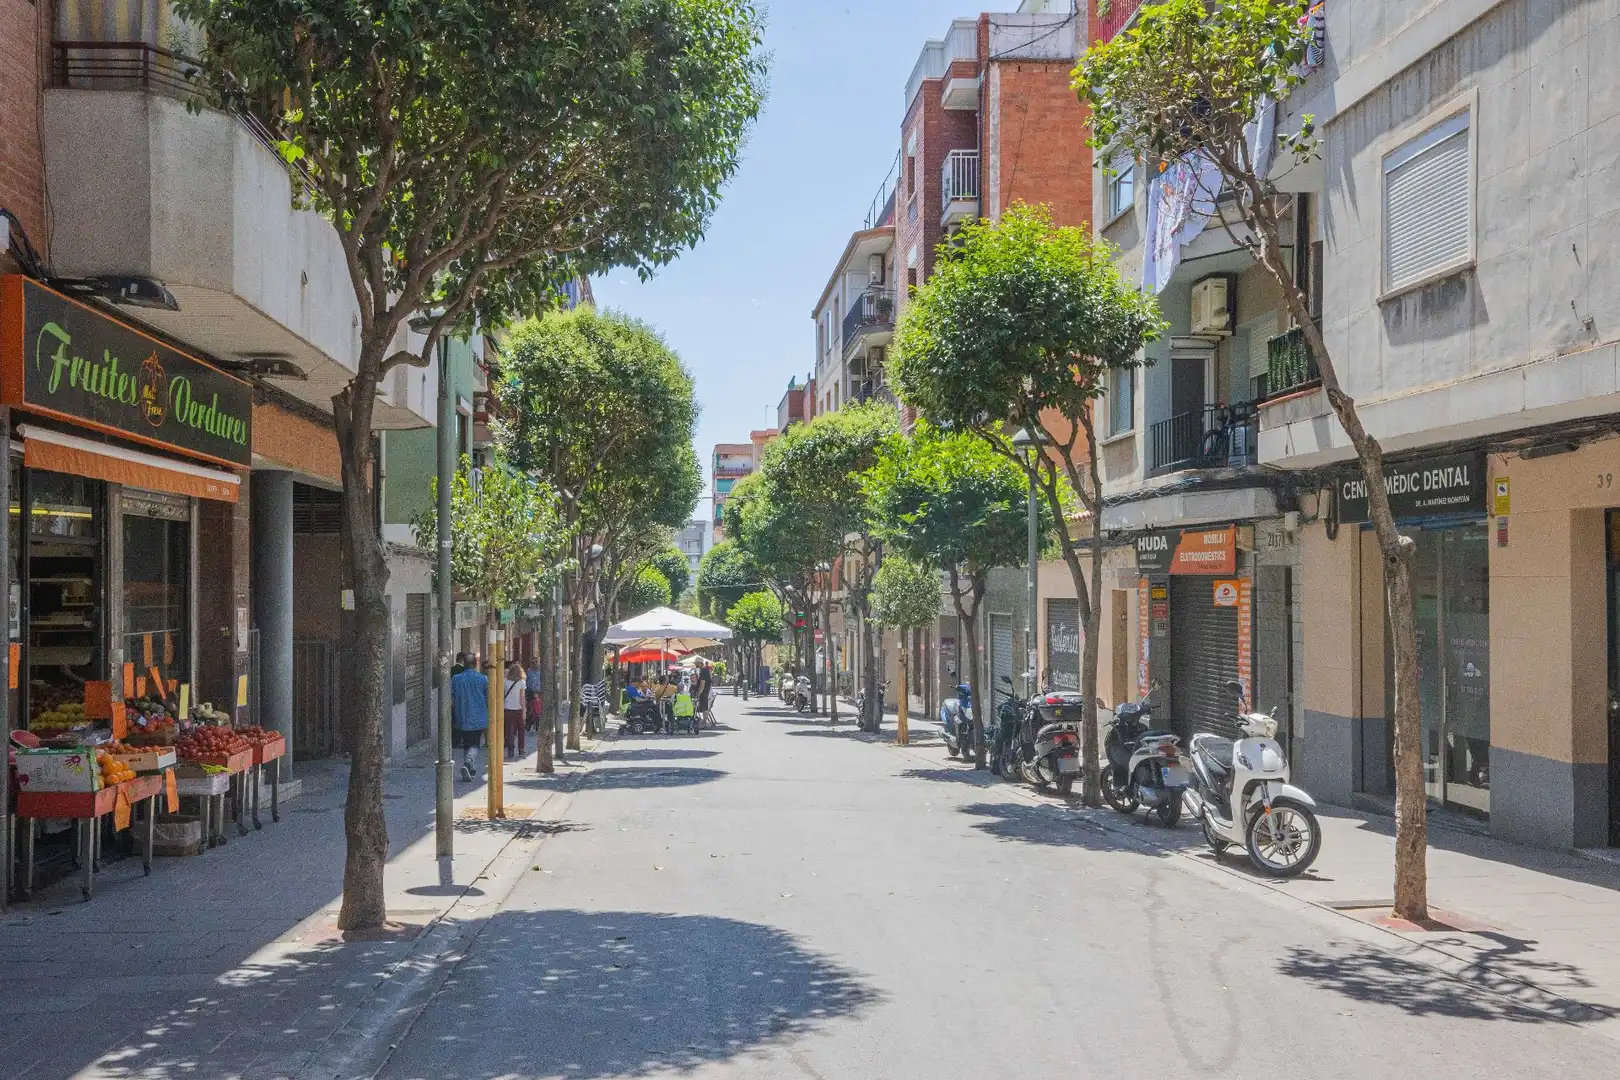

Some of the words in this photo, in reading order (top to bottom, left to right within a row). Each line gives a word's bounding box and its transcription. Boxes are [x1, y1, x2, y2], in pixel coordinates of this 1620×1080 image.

[37, 322, 139, 406] Fruites
[169, 376, 247, 446] Verdures
[1343, 480, 1368, 500] CENT
[1384, 469, 1420, 495] MÈDIC
[1423, 465, 1470, 490] DENTAL
[1597, 473, 1612, 488] 39
[1138, 535, 1168, 551] HUDA
